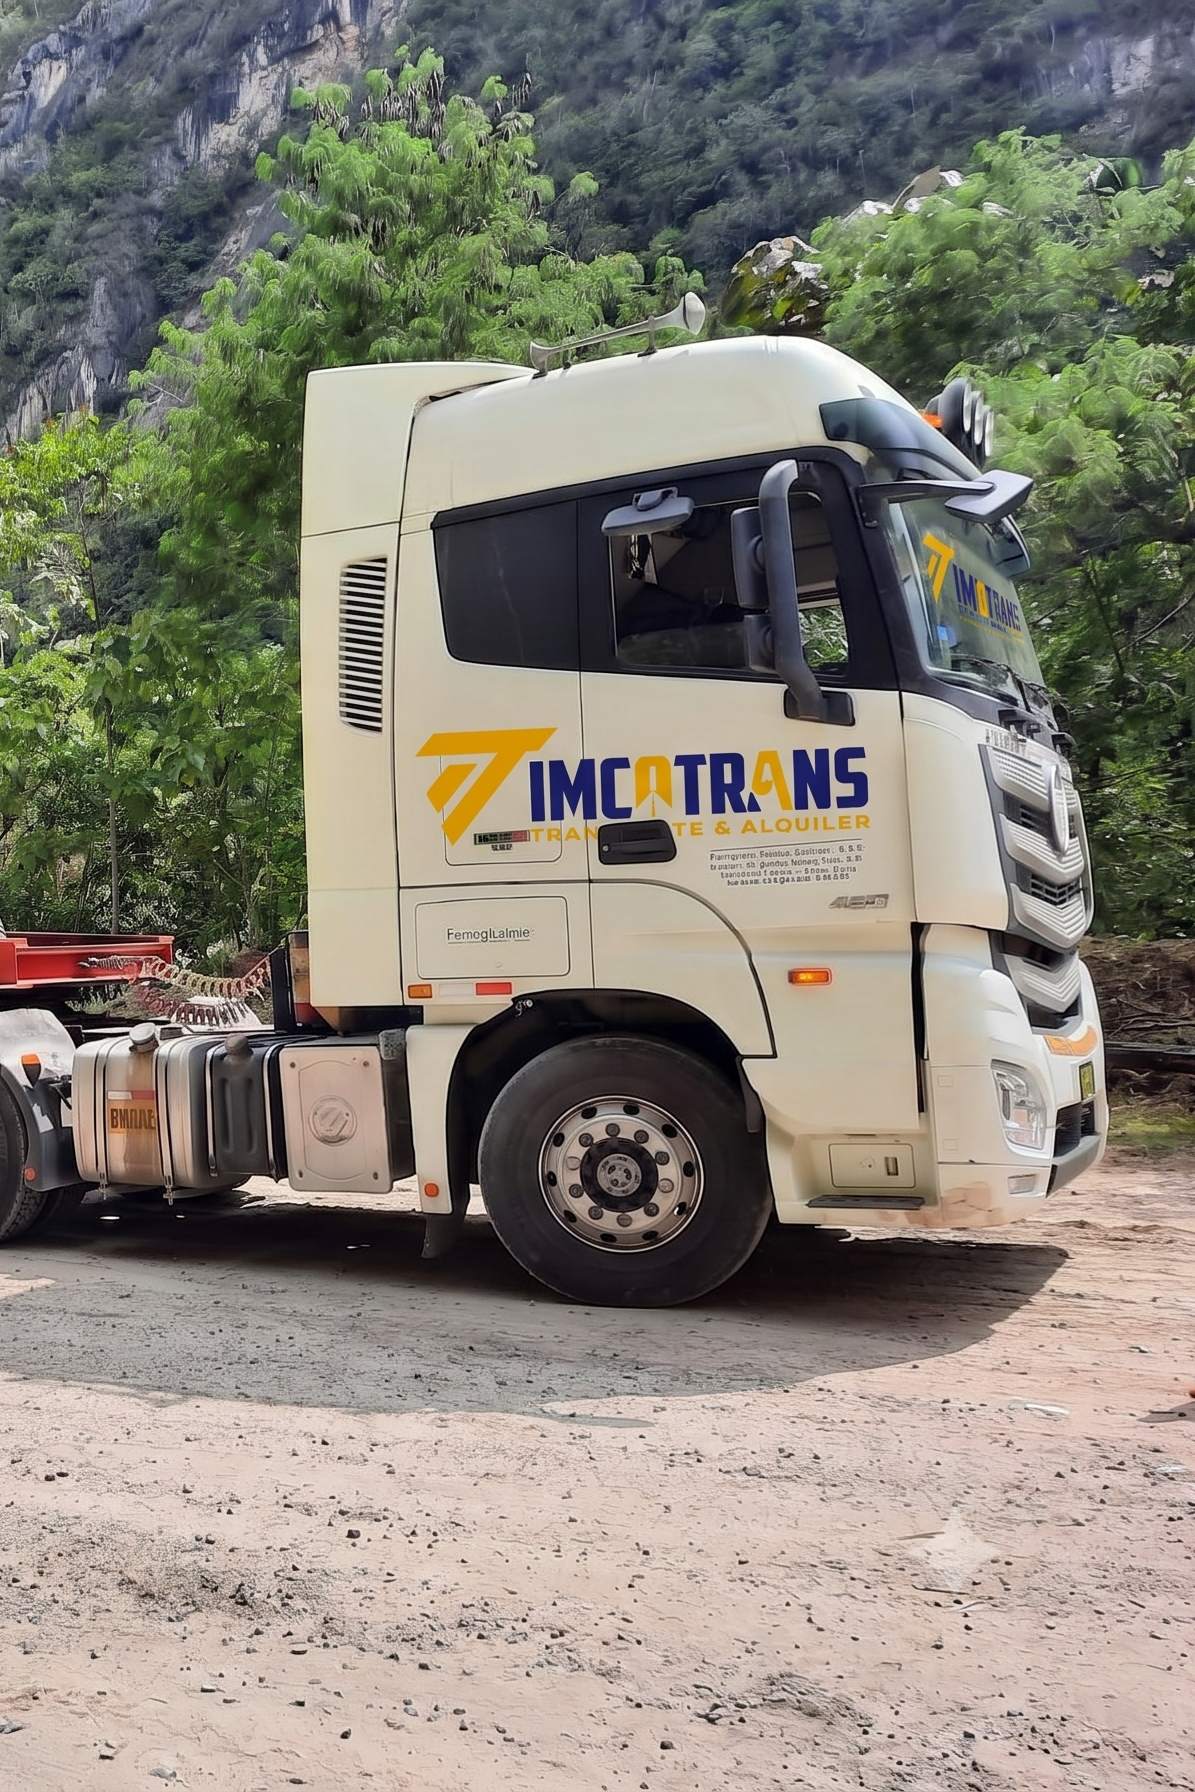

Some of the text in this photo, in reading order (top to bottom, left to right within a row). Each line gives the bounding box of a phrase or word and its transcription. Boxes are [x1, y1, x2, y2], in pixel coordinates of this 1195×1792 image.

[531, 820, 704, 843] TRANTE
[715, 820, 731, 835] &
[741, 815, 871, 834] ALQUILER
